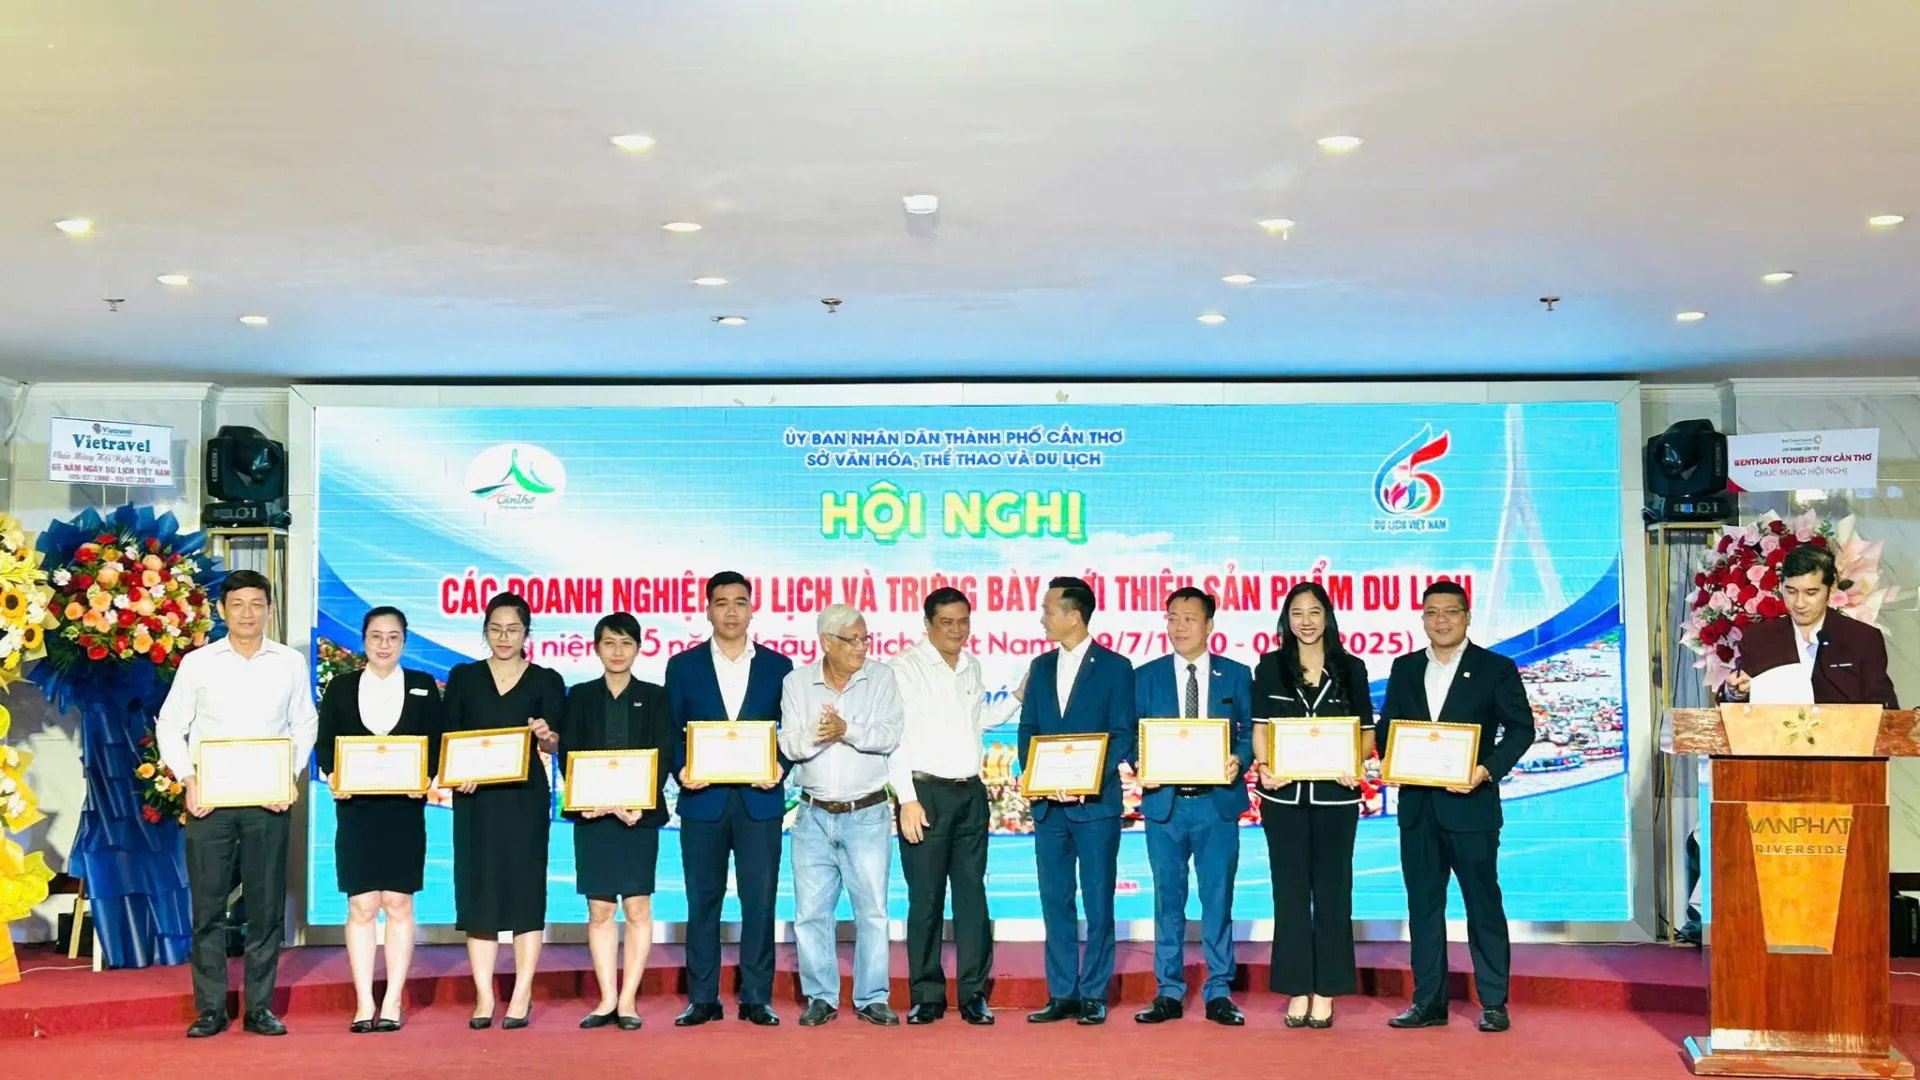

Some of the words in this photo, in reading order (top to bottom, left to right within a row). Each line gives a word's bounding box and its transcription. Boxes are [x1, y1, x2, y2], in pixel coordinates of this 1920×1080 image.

[73, 434, 151, 453] Vietravel
[786, 428, 806, 445] ỦY
[812, 432, 845, 445] BAN
[851, 429, 899, 445] NHÂN
[905, 429, 940, 445] DÂN
[945, 429, 1001, 444] THÀNH
[1006, 427, 1042, 444] PHỐ
[1047, 425, 1084, 444] CẦN
[1089, 430, 1123, 444] THƠ
[807, 449, 829, 466] SỞ
[835, 451, 870, 466] VĂN
[876, 451, 918, 468] HÓA,
[923, 447, 952, 466] THỂ
[956, 453, 1001, 466] THAO
[1006, 449, 1031, 465] VÀ
[1035, 453, 1057, 465] DU
[1063, 452, 1101, 470] LỊCH
[1782, 455, 1817, 464] TOURIST
[821, 479, 925, 544] HỘI
[943, 491, 1087, 544] NGHỊ
[442, 570, 498, 614] CÁC
[771, 576, 832, 621] LỊCH
[842, 569, 878, 613] VÀ
[987, 569, 1041, 612] BÀY
[1203, 563, 1261, 612] SẢN
[1363, 575, 1400, 611] DU
[988, 631, 1056, 656] Nam
[1755, 844, 1846, 854] RIVERSIDE
